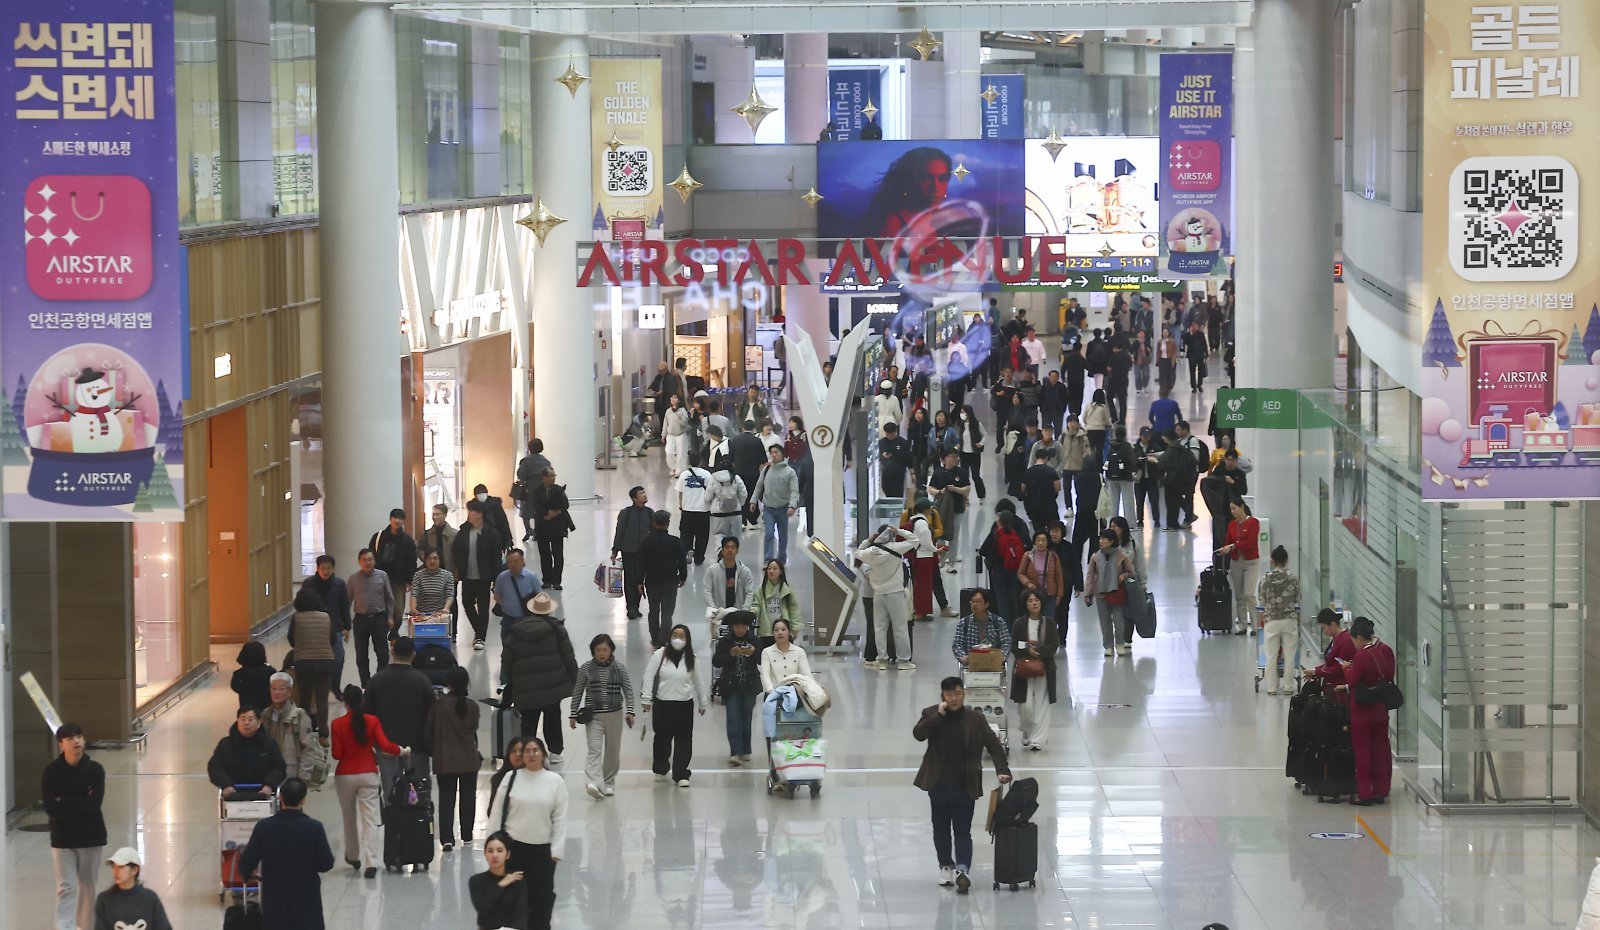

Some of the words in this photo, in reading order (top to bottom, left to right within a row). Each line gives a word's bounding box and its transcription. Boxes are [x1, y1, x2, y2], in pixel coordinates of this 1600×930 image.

[1471, 5, 1560, 50] 골든
[14, 22, 154, 68] 쓰면돼
[1179, 75, 1213, 88] JUST
[1450, 55, 1580, 99] 피날레
[615, 81, 637, 94] THE
[853, 82, 861, 103] FOOD
[15, 75, 155, 120] 스면세
[1176, 89, 1201, 102] USE
[1204, 89, 1217, 102] IT
[604, 96, 649, 109] GOLDEN
[606, 111, 648, 124] FINALE
[853, 105, 861, 129] COURT
[1169, 104, 1222, 119] AIRSTAR
[1516, 121, 1549, 135] 설렘과
[1177, 172, 1213, 180] AIRSTAR
[47, 255, 133, 273] AIRSTAR
[576, 238, 812, 287] AIRSTAR
[826, 236, 1067, 284] AVENUE
[1065, 258, 1093, 268] 12-25
[1103, 274, 1140, 283] Transfer
[866, 303, 899, 313] LOEWE
[1451, 292, 1575, 311] 인천공항면세점앱
[28, 312, 152, 329] 인천공항면세점앱
[1498, 371, 1548, 383] AIRSTAR
[1262, 401, 1281, 410] AED
[1225, 413, 1244, 421] AED
[77, 473, 132, 485] AIRSTAR
